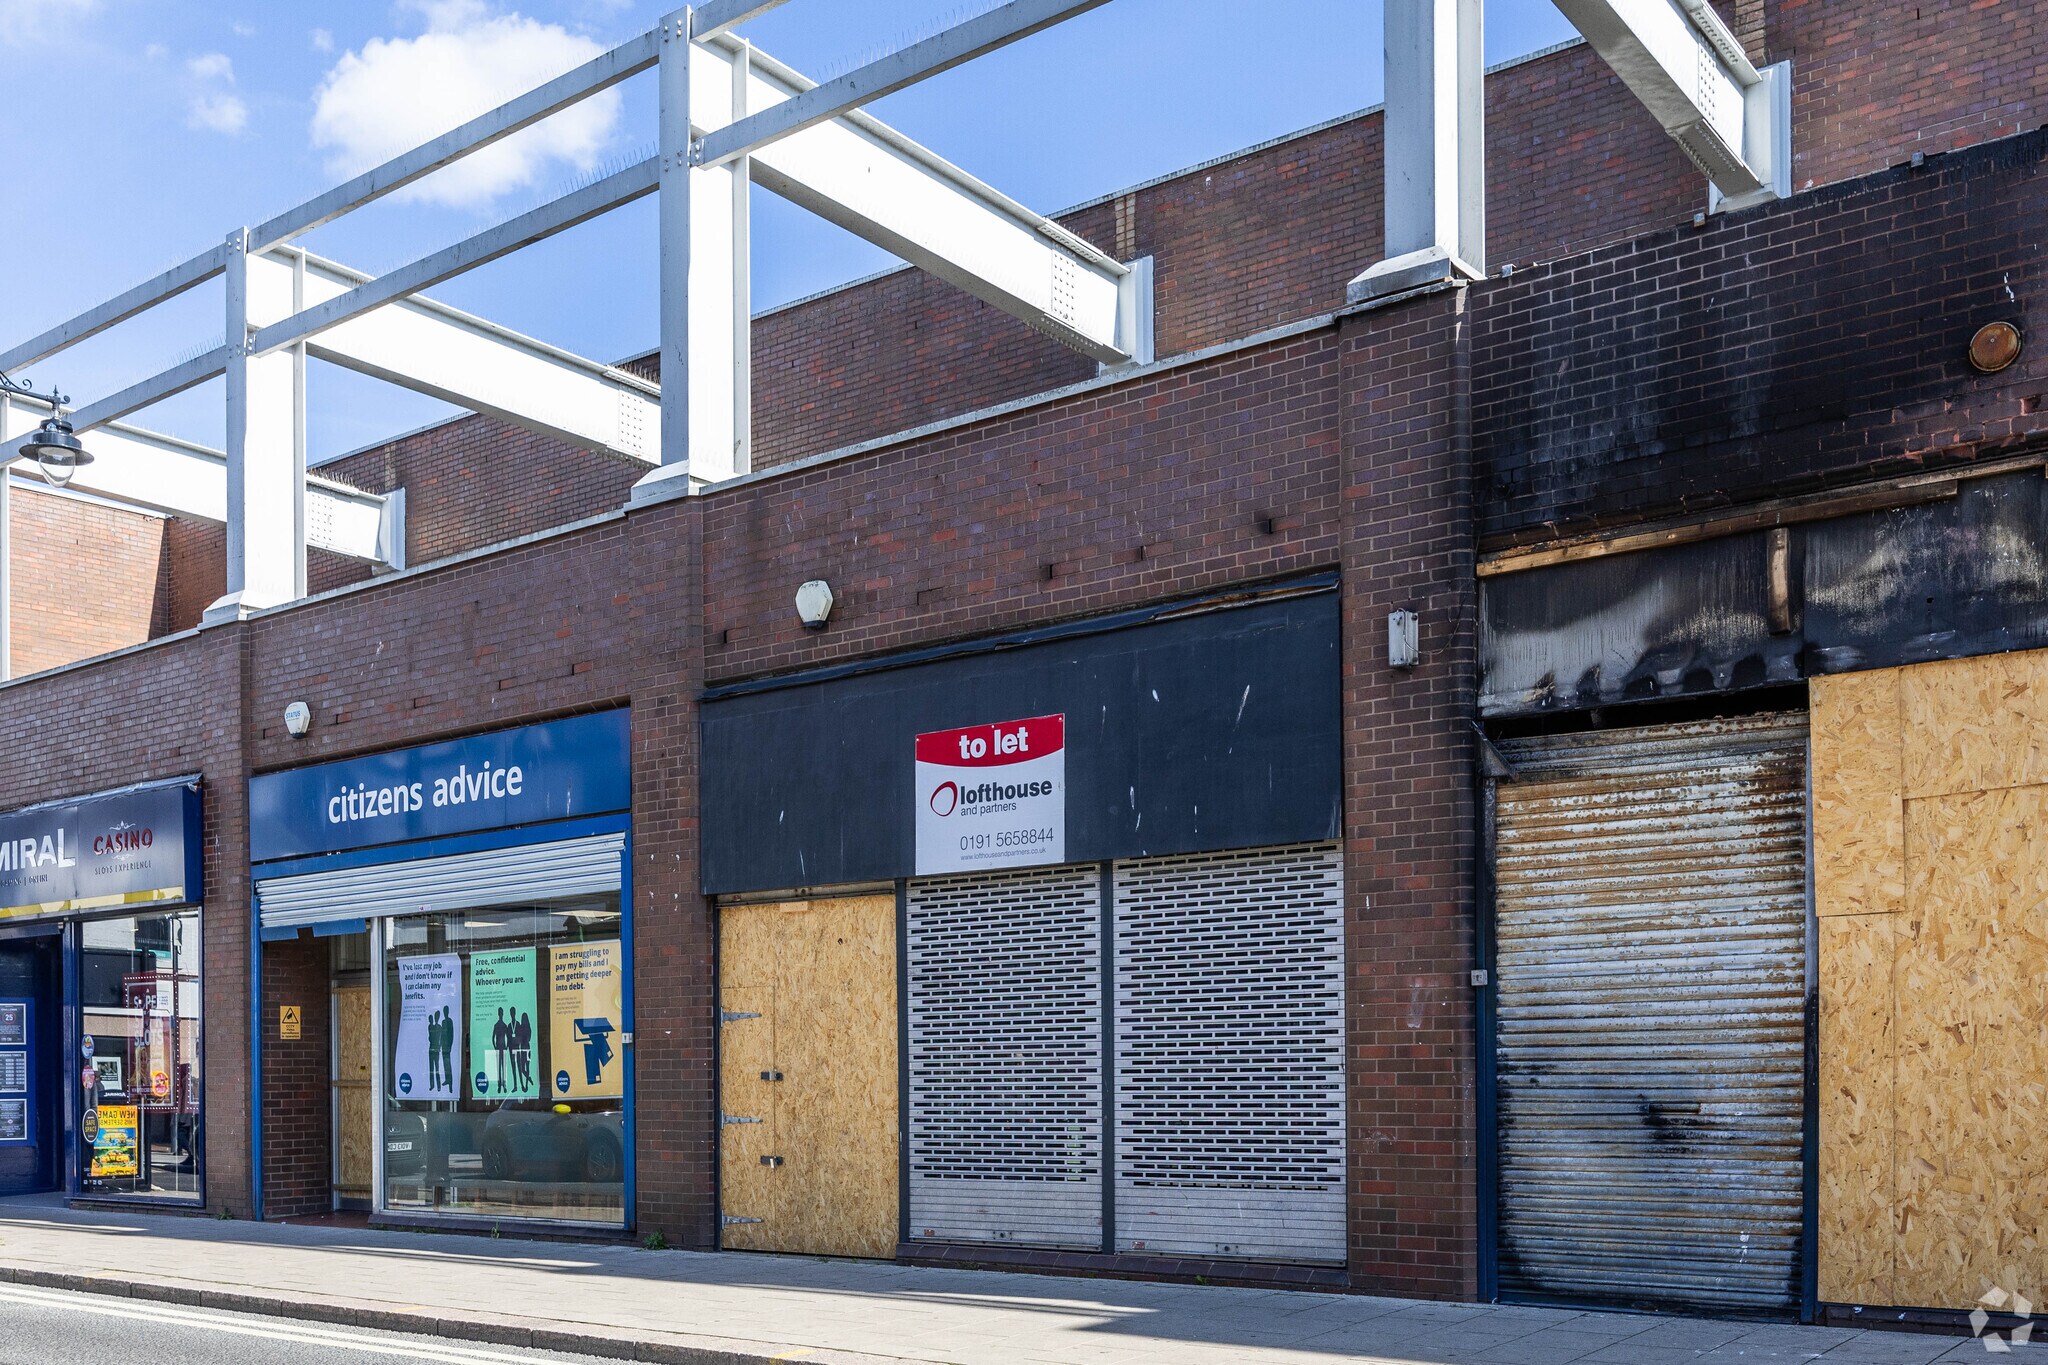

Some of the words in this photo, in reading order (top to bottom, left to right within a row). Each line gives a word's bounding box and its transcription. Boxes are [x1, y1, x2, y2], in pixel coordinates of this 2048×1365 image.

[958, 735, 987, 760] to
[993, 726, 1029, 756] let
[328, 781, 423, 825] citizens
[432, 760, 523, 808] advice
[960, 780, 1053, 805] lofthouse
[960, 804, 978, 817] and
[980, 801, 1017, 817] partners
[93, 827, 154, 856] CASINO
[960, 834, 991, 851] 0191
[996, 827, 1054, 848] 5658844
[960, 846, 1046, 862] www.lofthouseandpartners.co.uk
[94, 865, 114, 876] SLOTS
[115, 860, 152, 873] EXPERIENCE
[475, 958, 490, 966] Free,
[490, 954, 526, 965] confidential
[569, 949, 602, 959] struggling
[403, 963, 413, 971] I've
[423, 963, 433, 972] my
[432, 962, 443, 971] job
[475, 967, 496, 976] advice.
[555, 964, 567, 972] pay
[567, 963, 578, 971] my
[578, 960, 592, 968] bills
[592, 959, 605, 967] and
[404, 973, 414, 981] and
[415, 972, 430, 980] don't
[430, 972, 446, 980] know
[447, 971, 453, 979] if
[475, 978, 501, 986] Whoever
[501, 978, 514, 986] you
[565, 971, 589, 982] getting
[589, 970, 612, 979] deeper
[414, 982, 431, 990] claim
[430, 983, 442, 991] any
[555, 984, 568, 992] into
[568, 982, 586, 990] debt.
[404, 992, 426, 1000] benefits.
